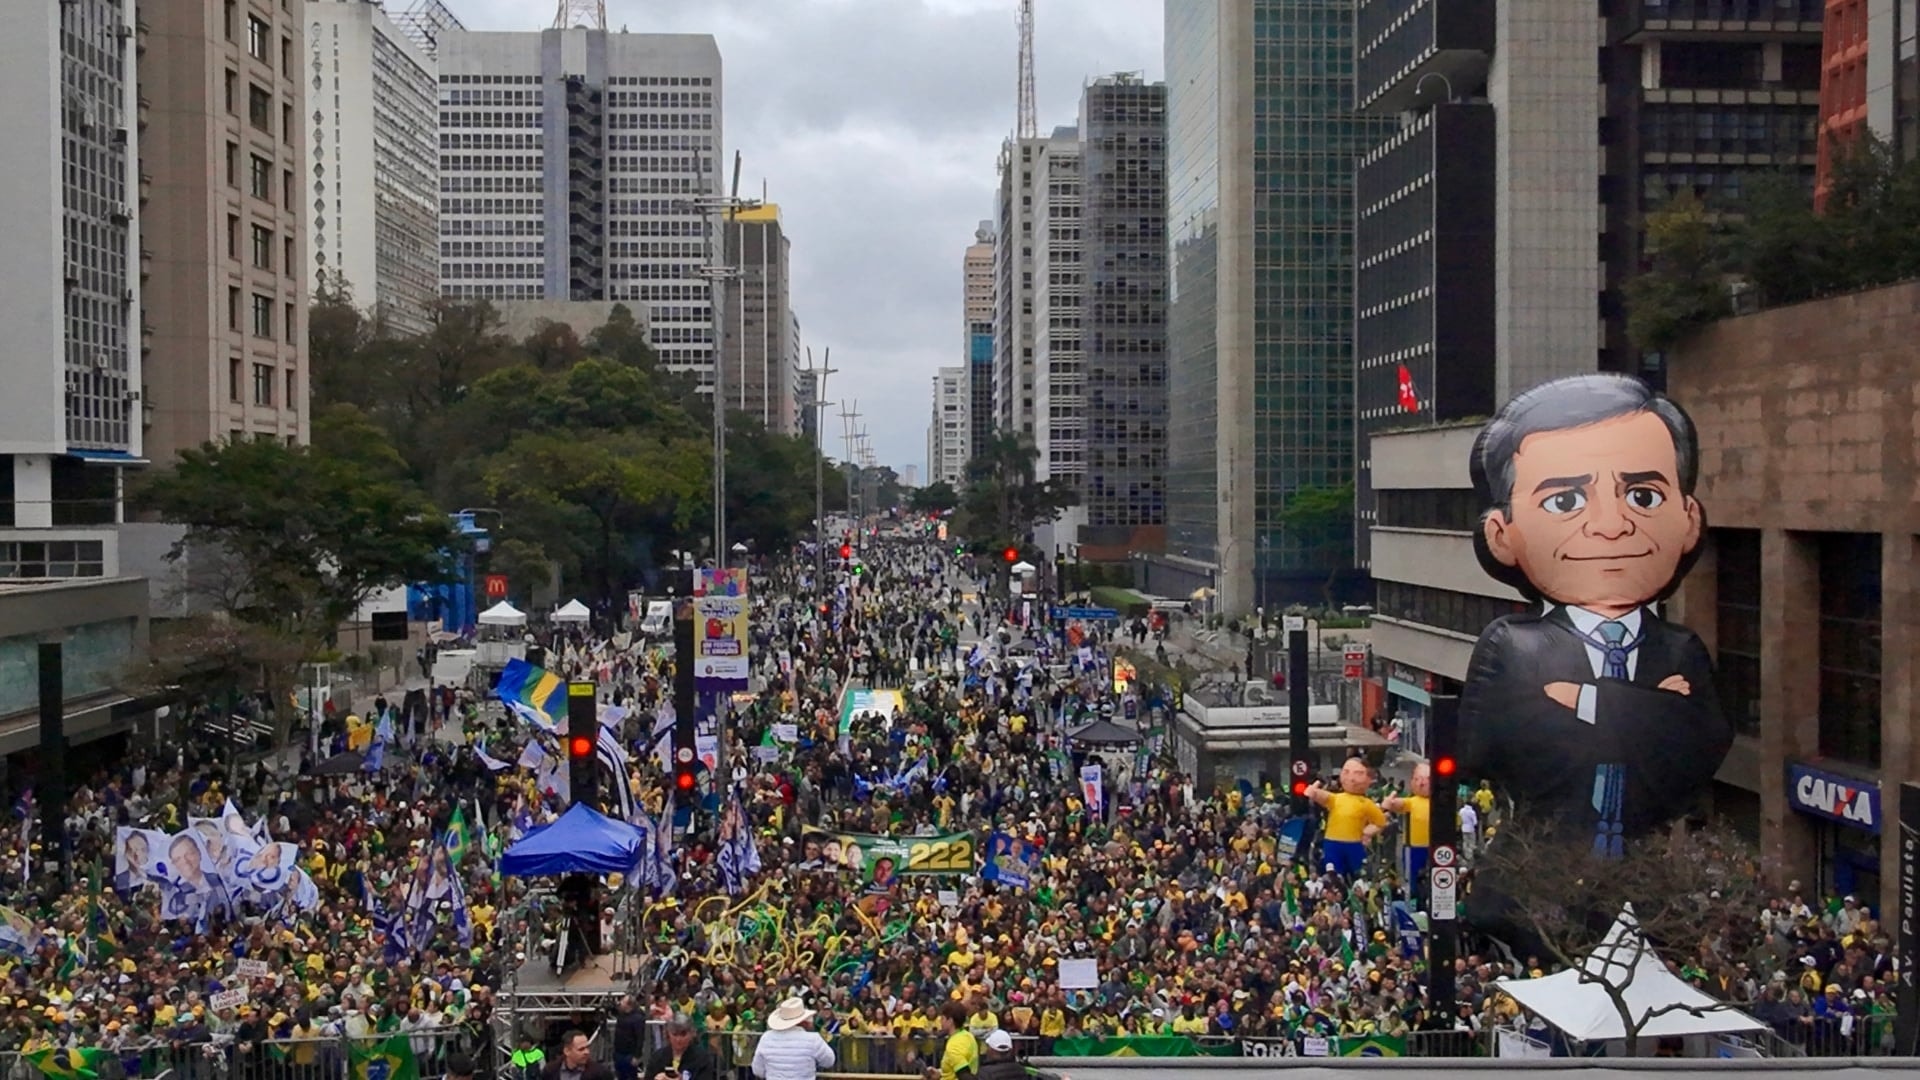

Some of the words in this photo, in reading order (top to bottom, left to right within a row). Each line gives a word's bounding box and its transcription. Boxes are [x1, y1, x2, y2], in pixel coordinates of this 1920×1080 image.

[1797, 775, 1873, 825] CAIXA
[909, 840, 971, 870] 222
[1437, 850, 1451, 860] 50
[1902, 839, 1914, 935] Paulista
[1902, 949, 1913, 987] Av.
[1242, 1040, 1298, 1057] FORA
